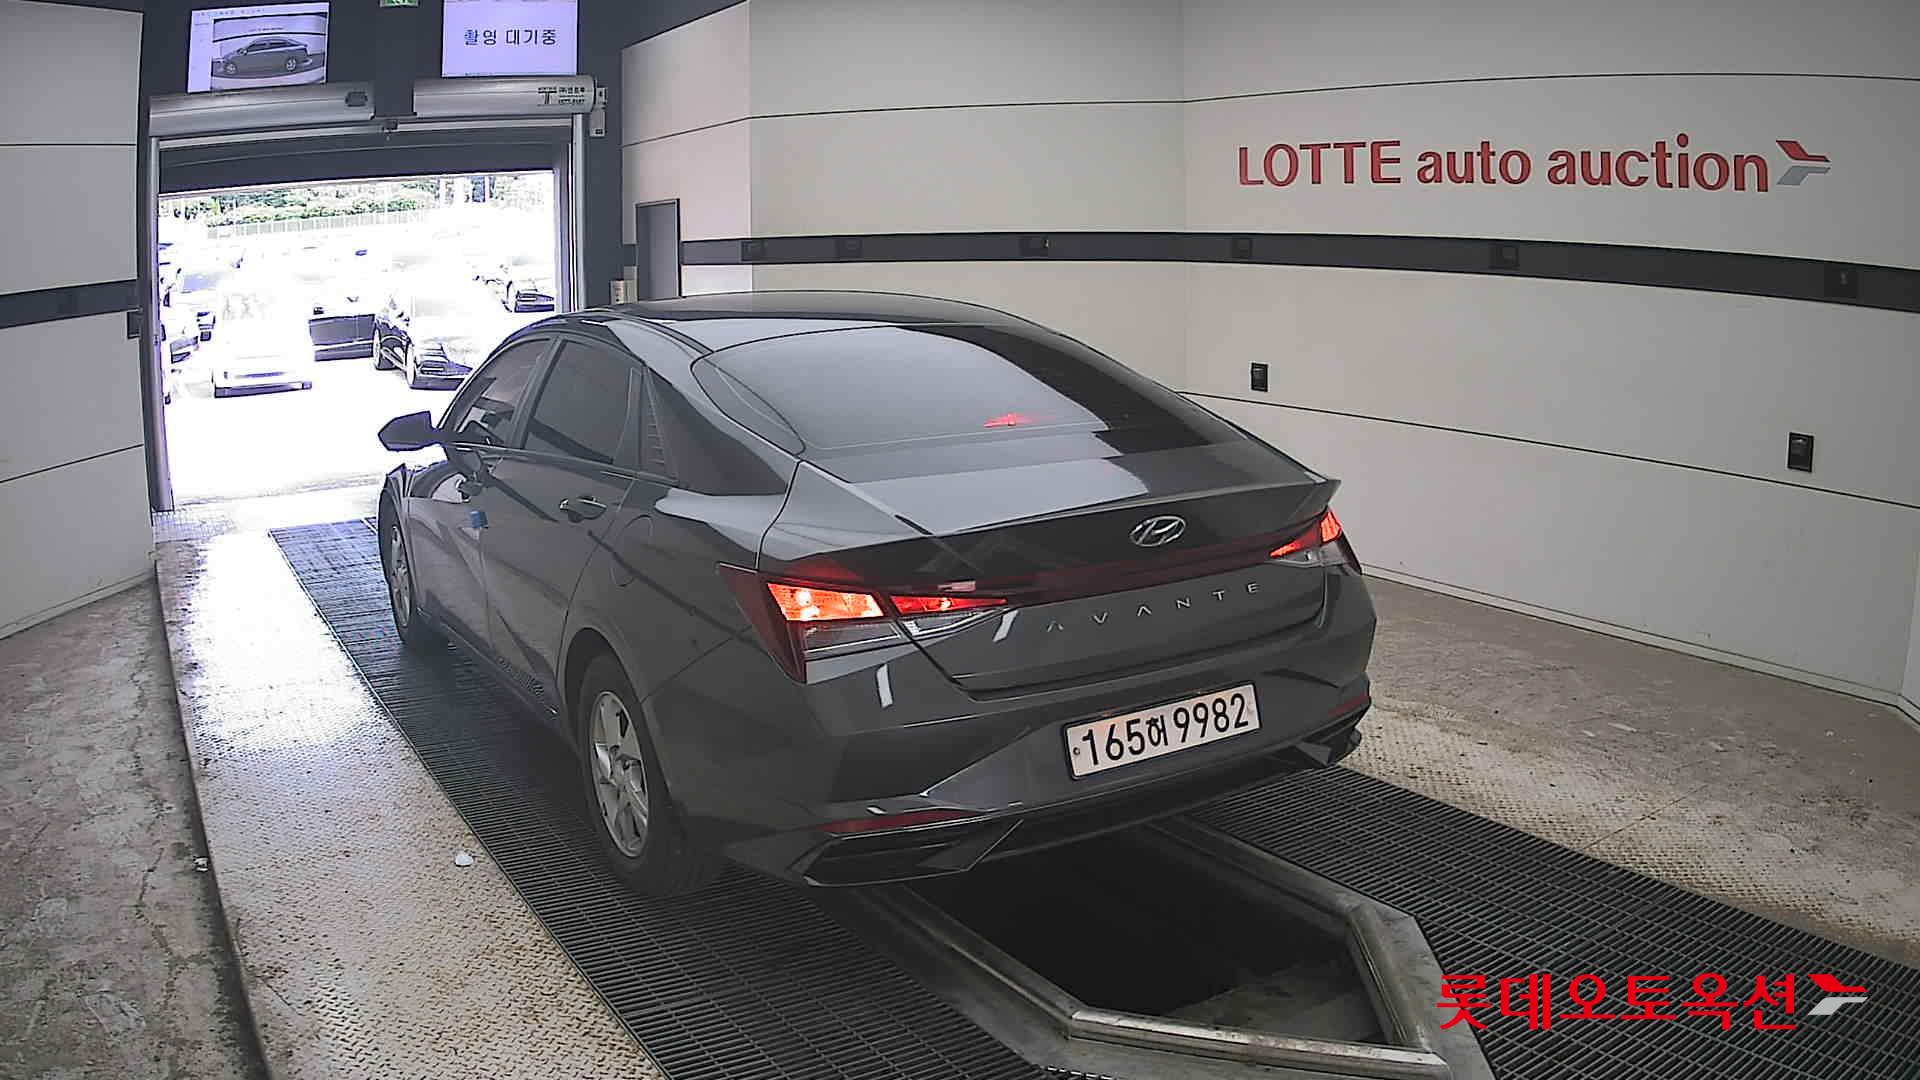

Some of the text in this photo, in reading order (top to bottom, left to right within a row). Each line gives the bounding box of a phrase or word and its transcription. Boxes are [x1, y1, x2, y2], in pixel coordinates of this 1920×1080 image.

[505, 29, 556, 46] 대기중
[1239, 134, 1769, 191] LOTTE auto auction
[1047, 582, 1261, 632] AVANTE
